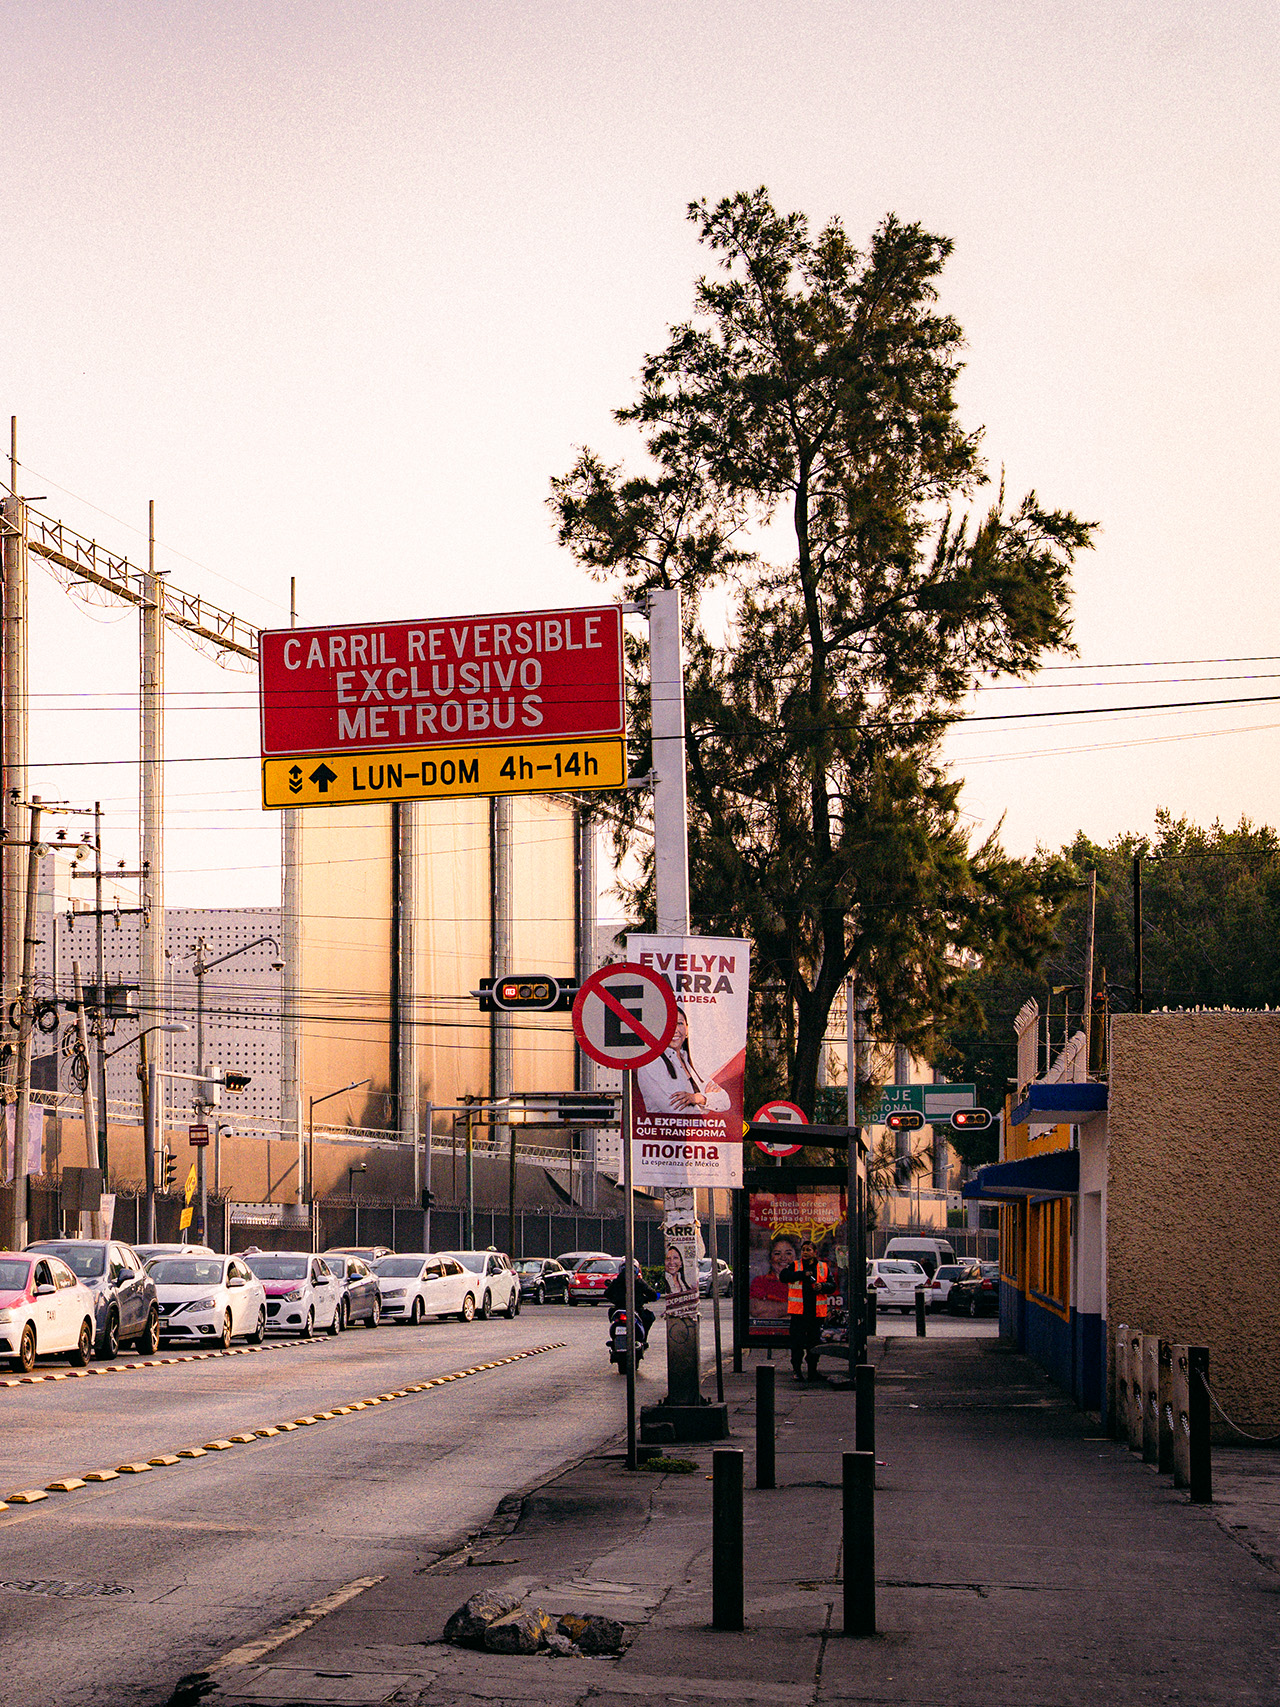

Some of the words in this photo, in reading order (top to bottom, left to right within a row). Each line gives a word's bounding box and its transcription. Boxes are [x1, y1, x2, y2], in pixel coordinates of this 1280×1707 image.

[284, 632, 396, 670] CARRIL
[408, 616, 602, 661] REVERSIBLE
[337, 658, 543, 703] EXCLUSIVO
[338, 695, 544, 740] METROBUS
[352, 758, 480, 791] LUN-DOM
[499, 750, 599, 782] 4h-14h
[640, 952, 735, 973] EVELYN
[660, 973, 734, 994] ARRA
[675, 995, 717, 1004] ALDESA
[636, 1117, 652, 1126] LA
[654, 1117, 727, 1128] EXPERIENCIA
[636, 1127, 657, 1136] QUE
[660, 1128, 727, 1138] TRANSFORMA
[642, 1143, 719, 1160] morena
[695, 1160, 719, 1168] México
